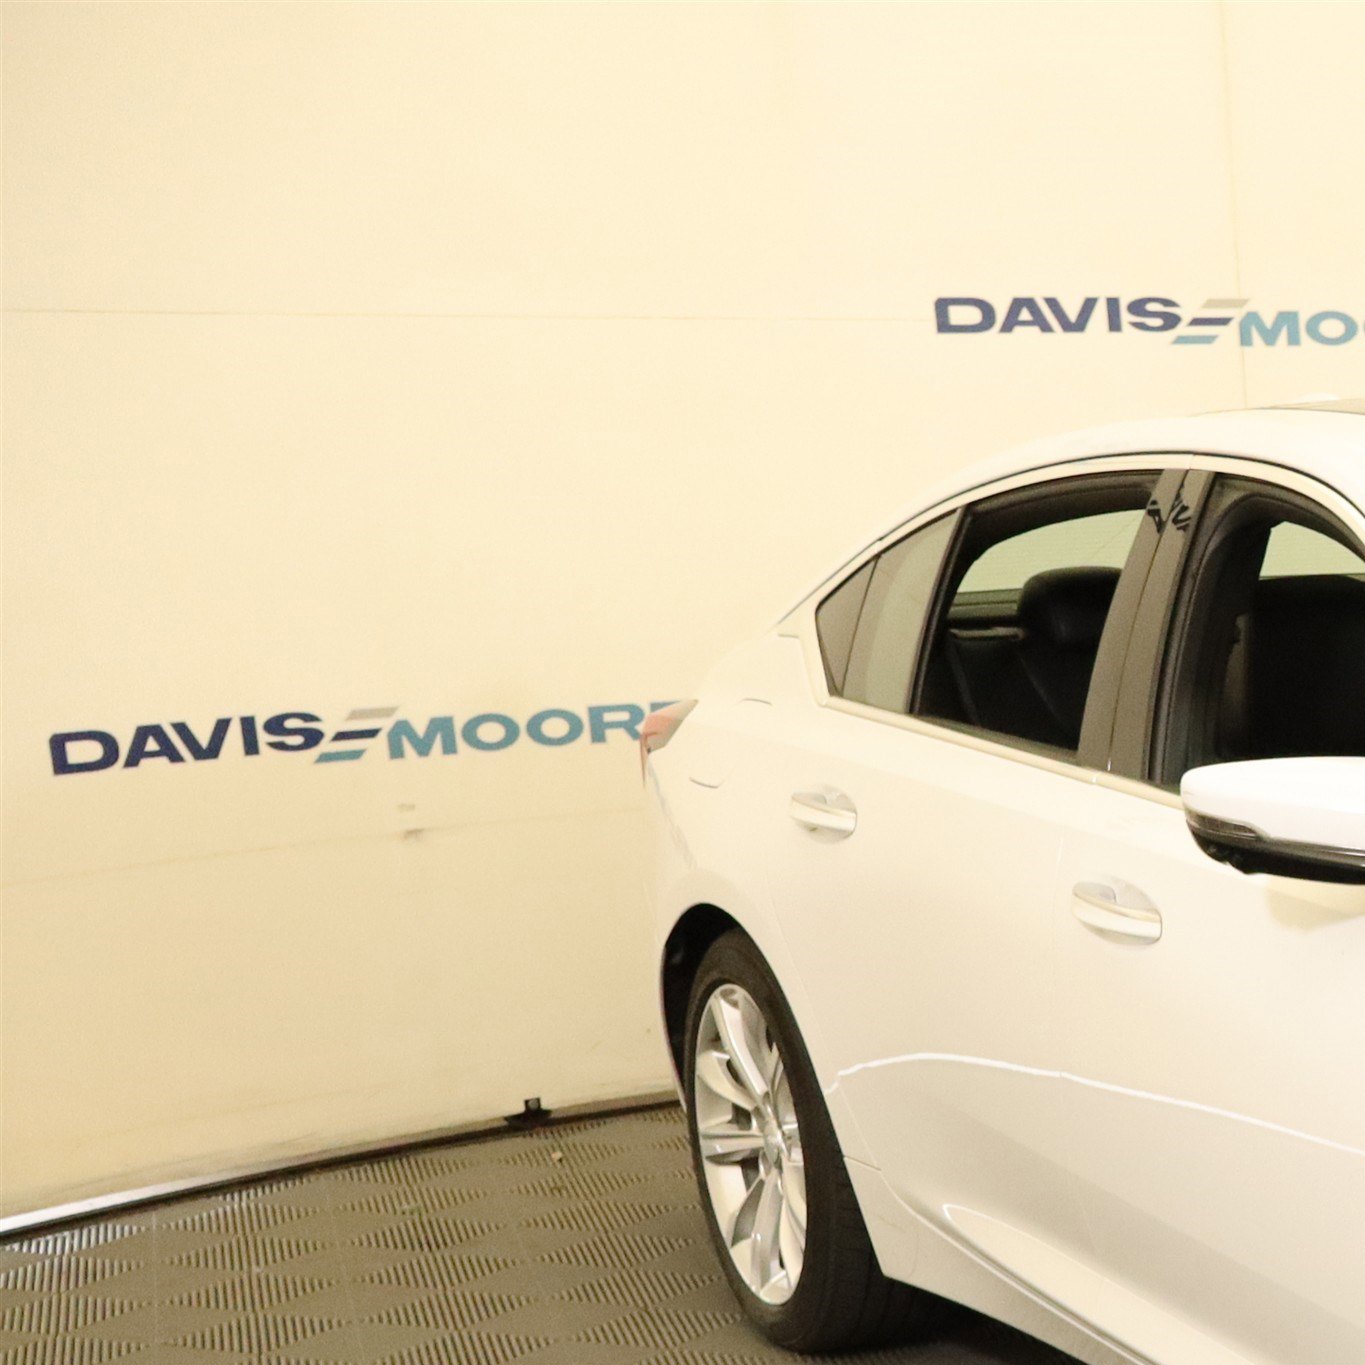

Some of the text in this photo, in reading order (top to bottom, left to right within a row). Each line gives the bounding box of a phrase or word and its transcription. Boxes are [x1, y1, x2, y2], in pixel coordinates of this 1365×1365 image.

[935, 297, 1181, 334] DAVIS
[49, 700, 680, 775] DAVIS MOOR
